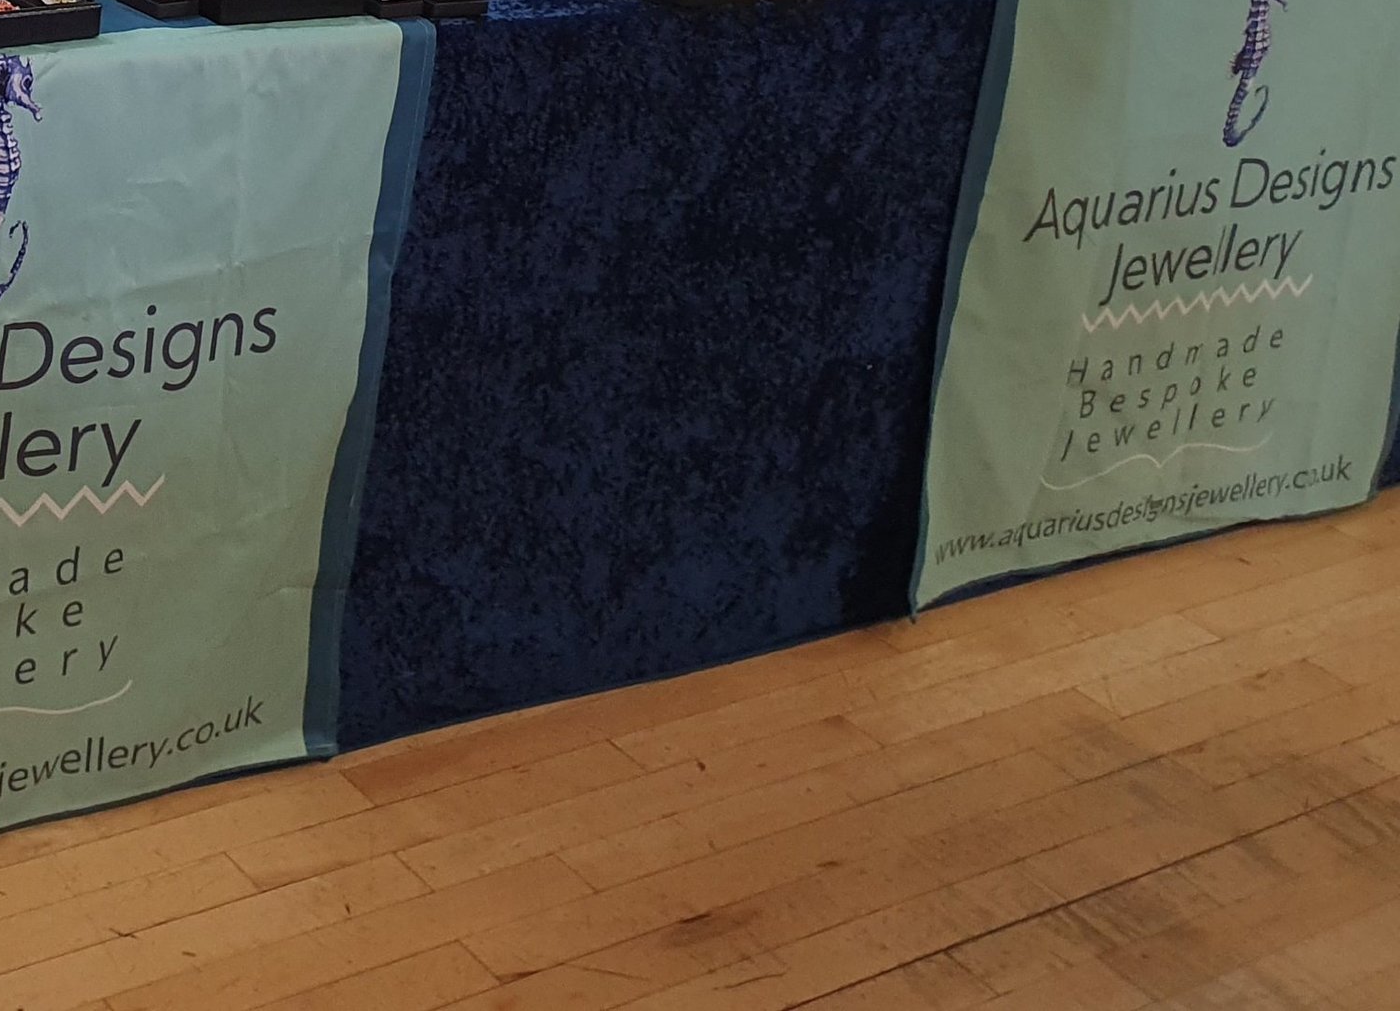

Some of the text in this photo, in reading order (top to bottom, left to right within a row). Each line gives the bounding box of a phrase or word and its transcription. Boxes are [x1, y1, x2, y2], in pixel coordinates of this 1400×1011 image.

[1023, 149, 1397, 250] Aquarius Designs
[1099, 223, 1303, 307] Jewellery
[1066, 325, 1285, 386] Handmade
[1079, 363, 1257, 419] Bespoke
[1060, 396, 1275, 462] Jewellery
